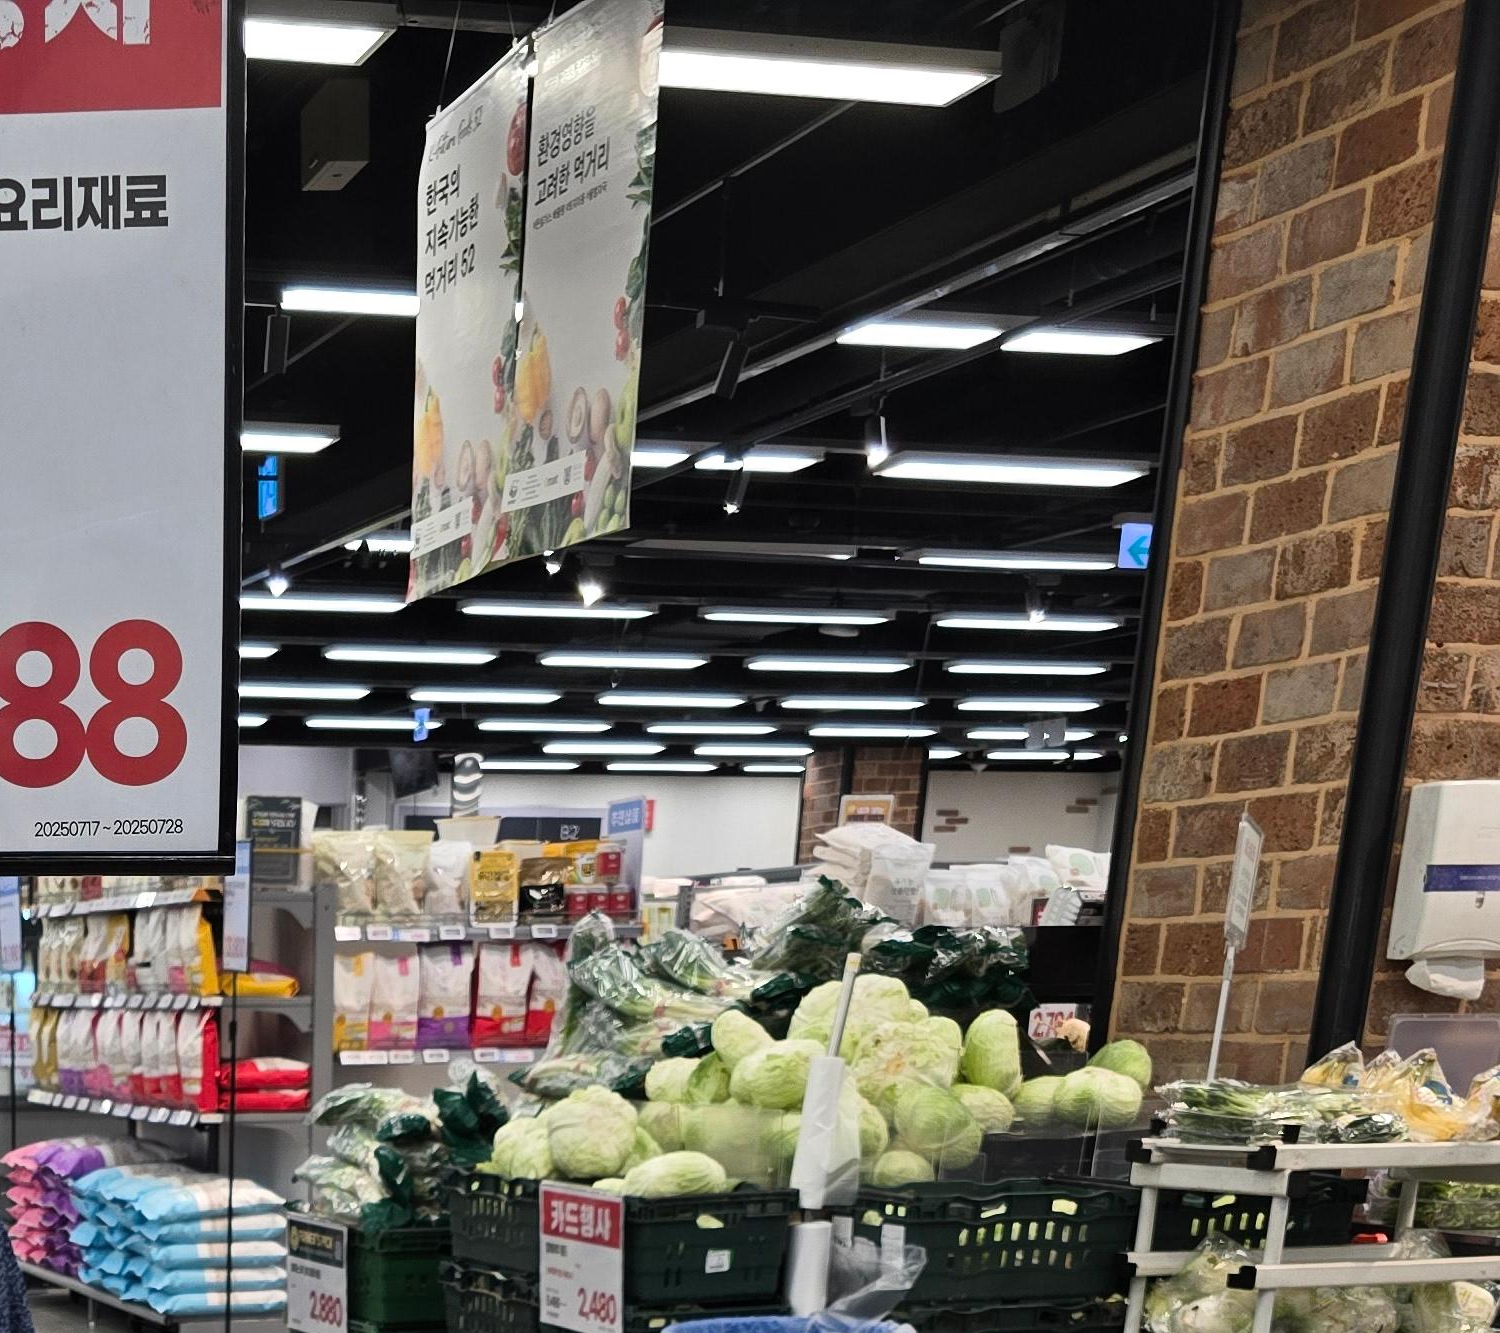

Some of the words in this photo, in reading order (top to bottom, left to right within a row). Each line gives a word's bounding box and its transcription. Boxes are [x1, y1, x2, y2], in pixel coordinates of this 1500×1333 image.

[537, 106, 597, 167] 환경영향을
[427, 164, 461, 217] 한국의
[535, 160, 571, 206] 고려한
[574, 136, 611, 185] 먹거리
[425, 193, 480, 258] 지속가능한
[425, 253, 458, 300] 먹거리
[461, 243, 477, 279] 52
[560, 824, 580, 840] B2
[550, 1198, 612, 1241] 카드행사
[309, 1290, 343, 1327] 2,880
[577, 1287, 617, 1325] 2,480
